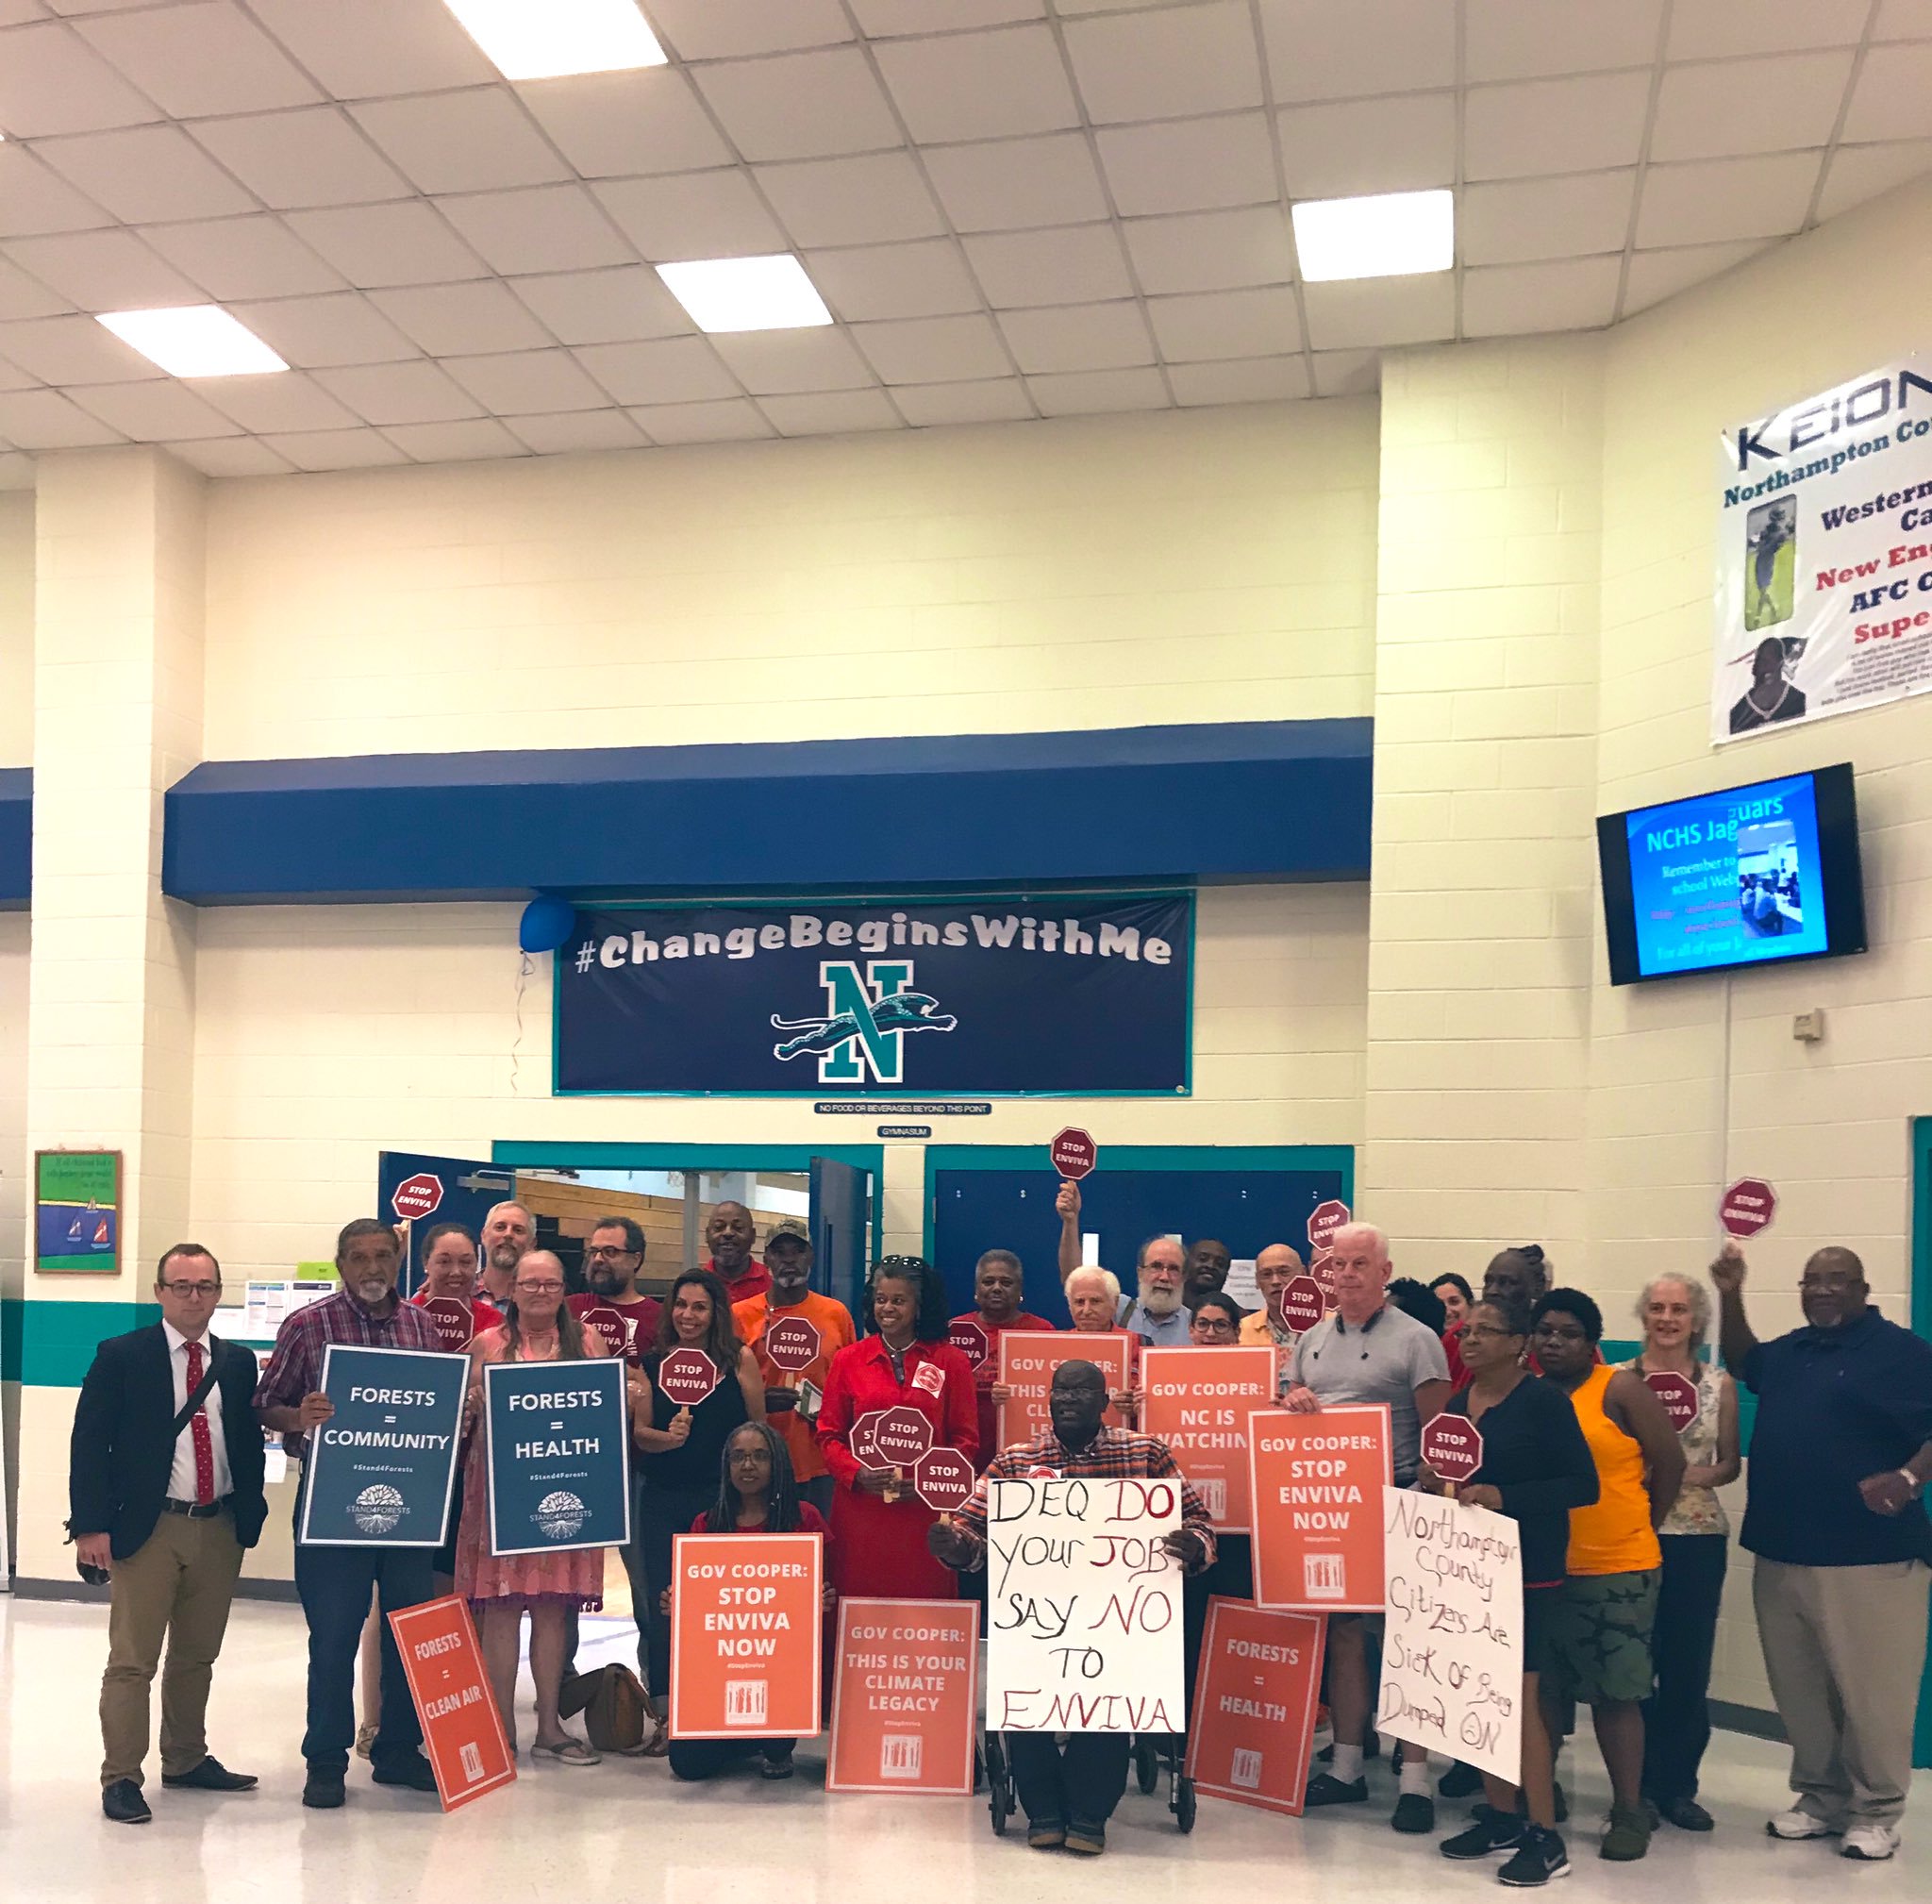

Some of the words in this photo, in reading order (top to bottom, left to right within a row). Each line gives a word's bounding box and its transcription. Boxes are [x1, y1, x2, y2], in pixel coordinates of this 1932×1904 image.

[1724, 434, 1890, 509] Northampton
[1896, 416, 1932, 443] Co
[1821, 479, 1932, 531] Western
[1816, 559, 1881, 591] New
[1888, 543, 1932, 569] En
[1850, 578, 1909, 613] AFC
[1646, 823, 1702, 853] NCHS
[1707, 797, 1784, 842] Jaguars
[1661, 858, 1722, 878] Remember
[1724, 856, 1737, 867] to
[1672, 877, 1708, 895] school
[575, 911, 1174, 974] #ChangeBeginsWithMe
[820, 1104, 831, 1112] NO
[832, 1104, 854, 1112] FOOD
[855, 1104, 866, 1112] OR
[867, 1104, 912, 1113] BEVERAGES
[913, 1105, 944, 1113] BEYOND
[946, 1105, 963, 1113] THIS
[964, 1105, 987, 1113] POINT
[882, 1127, 927, 1136] GYMNASIUM
[1061, 1142, 1086, 1153] STOP
[1056, 1153, 1090, 1167] ENVIVA
[408, 1185, 433, 1196] STOP
[397, 1195, 432, 1210] ENVIVA
[1318, 1213, 1341, 1227] STOP
[1322, 1270, 1335, 1279] ST
[1291, 1292, 1314, 1303] STOP
[1285, 1305, 1319, 1319] ENVIVA
[435, 1328, 465, 1339] VIVA
[604, 1336, 622, 1345] IVA
[780, 1331, 808, 1343] STOP
[949, 1336, 975, 1345] STOP
[772, 1344, 812, 1357] ENVIVA
[674, 1364, 703, 1376] STOP
[1011, 1359, 1044, 1371] GOV
[666, 1378, 708, 1391] ENVIVA
[1008, 1384, 1046, 1398] THIS
[1152, 1383, 1187, 1396] GOV
[1191, 1382, 1264, 1396] COOPER:
[350, 1387, 436, 1407] FORESTS
[508, 1390, 603, 1411] FORESTS
[1656, 1390, 1683, 1399] TOP
[1180, 1410, 1209, 1426] NC
[1217, 1410, 1235, 1426] IS
[889, 1422, 919, 1435] STOP
[324, 1429, 450, 1450] COMMUNITY
[880, 1436, 924, 1451] ENVIVA
[1260, 1438, 1296, 1452] GOV
[1302, 1436, 1377, 1451] COOPER:
[1436, 1431, 1468, 1446] STOP
[515, 1438, 600, 1459] HEALTH
[1428, 1446, 1474, 1465] ENVIVA
[929, 1465, 959, 1477] STOP
[1291, 1460, 1347, 1478] STOP
[923, 1480, 967, 1494] ENVIVA
[1279, 1485, 1362, 1504] ENVIVA
[990, 1479, 1089, 1523] DEQ
[1105, 1479, 1174, 1523] DO
[345, 1505, 411, 1515] STAND4FORESTS
[529, 1510, 592, 1522] STAND4FORESTS
[1293, 1512, 1350, 1530] NOW
[1090, 1535, 1169, 1583] JOB
[688, 1564, 725, 1579] GOV
[731, 1563, 808, 1578] COOPER:
[1416, 1545, 1493, 1602] County
[719, 1587, 776, 1605] STOP
[1390, 1576, 1469, 1633] Citizens
[1088, 1585, 1172, 1635] NO
[705, 1612, 791, 1630] ENVIVA
[851, 1626, 888, 1640] GOV
[892, 1628, 965, 1643] COOPER:
[414, 1631, 462, 1661] FORESTS
[717, 1638, 776, 1657] NOW
[1226, 1638, 1299, 1665] FORESTS
[846, 1653, 887, 1669] THIS
[892, 1654, 909, 1669] IS
[915, 1655, 966, 1671] YOUR
[1049, 1646, 1104, 1679] TO
[865, 1675, 945, 1692] CLIMATE
[425, 1693, 461, 1720] CLEAN
[463, 1685, 482, 1704] AIR
[868, 1695, 940, 1712] LEGACY
[1001, 1689, 1176, 1733] ENVIVA
[1220, 1695, 1287, 1722] HEALTH
